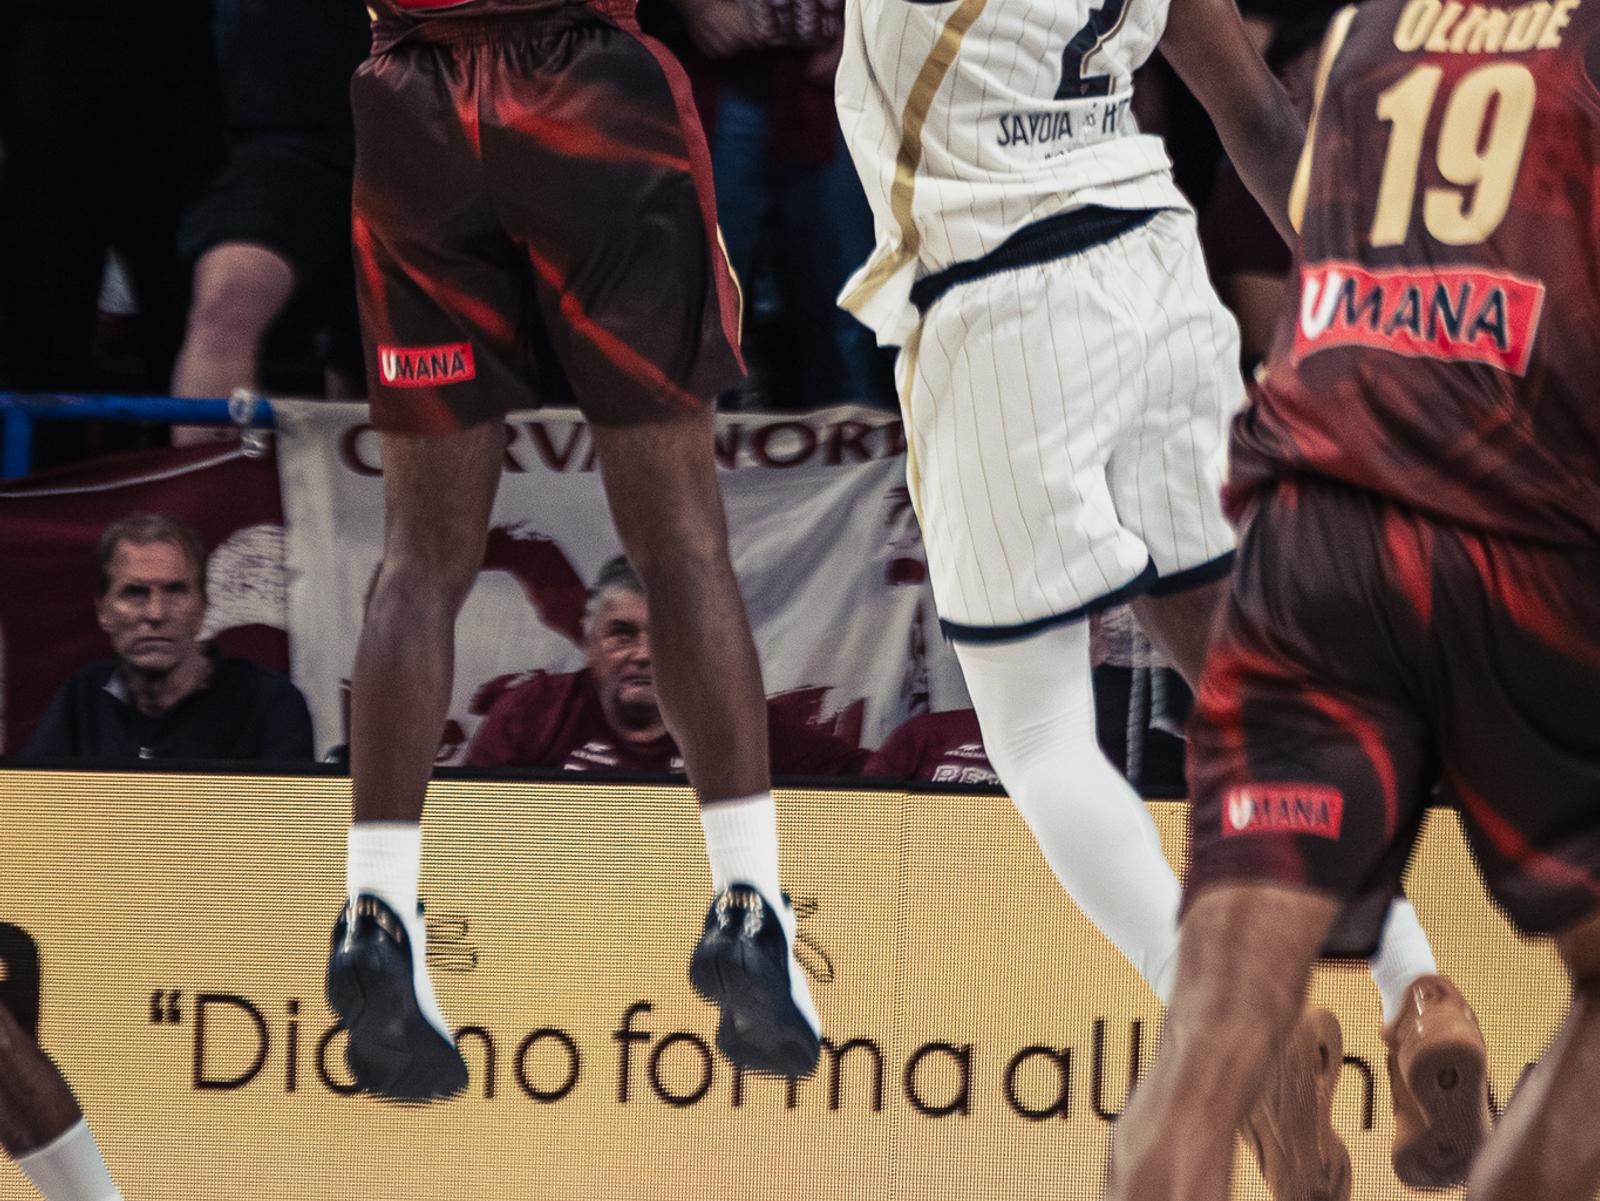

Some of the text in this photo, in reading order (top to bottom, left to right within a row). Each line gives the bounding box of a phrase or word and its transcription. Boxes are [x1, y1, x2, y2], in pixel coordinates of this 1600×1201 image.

[996, 111, 1073, 147] SAVOIA
[1371, 61, 1537, 248] 19
[1301, 270, 1509, 353] UMANA
[381, 349, 467, 382] UMANA
[613, 1000, 973, 1118] foma
